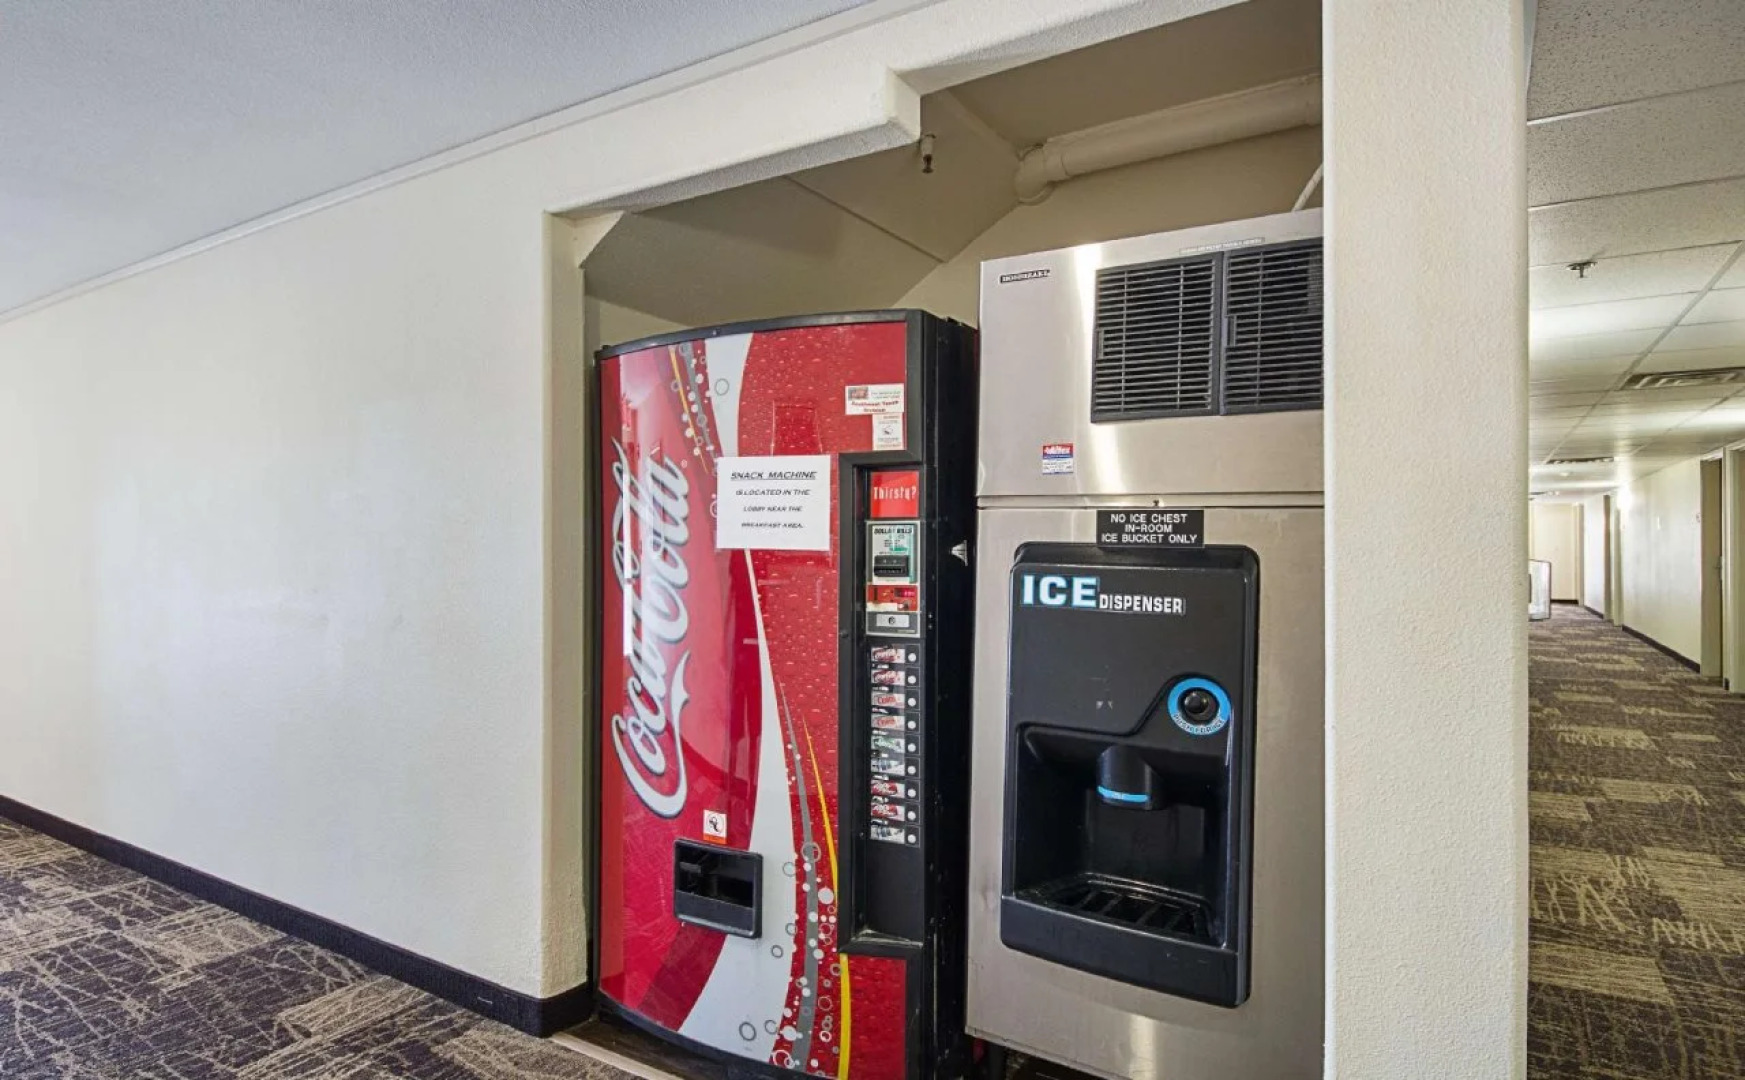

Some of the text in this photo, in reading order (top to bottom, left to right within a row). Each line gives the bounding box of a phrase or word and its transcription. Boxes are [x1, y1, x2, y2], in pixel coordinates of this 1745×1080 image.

[731, 471, 817, 480] SNACK MACHINE
[873, 485, 917, 501] Thirsty?
[1110, 513, 1188, 523] NO ICE CHEST
[1125, 524, 1173, 533] IN-ROOM
[1101, 533, 1198, 543] ICE BUCKET ONLY
[1022, 574, 1184, 614] ICE DISPENSER
